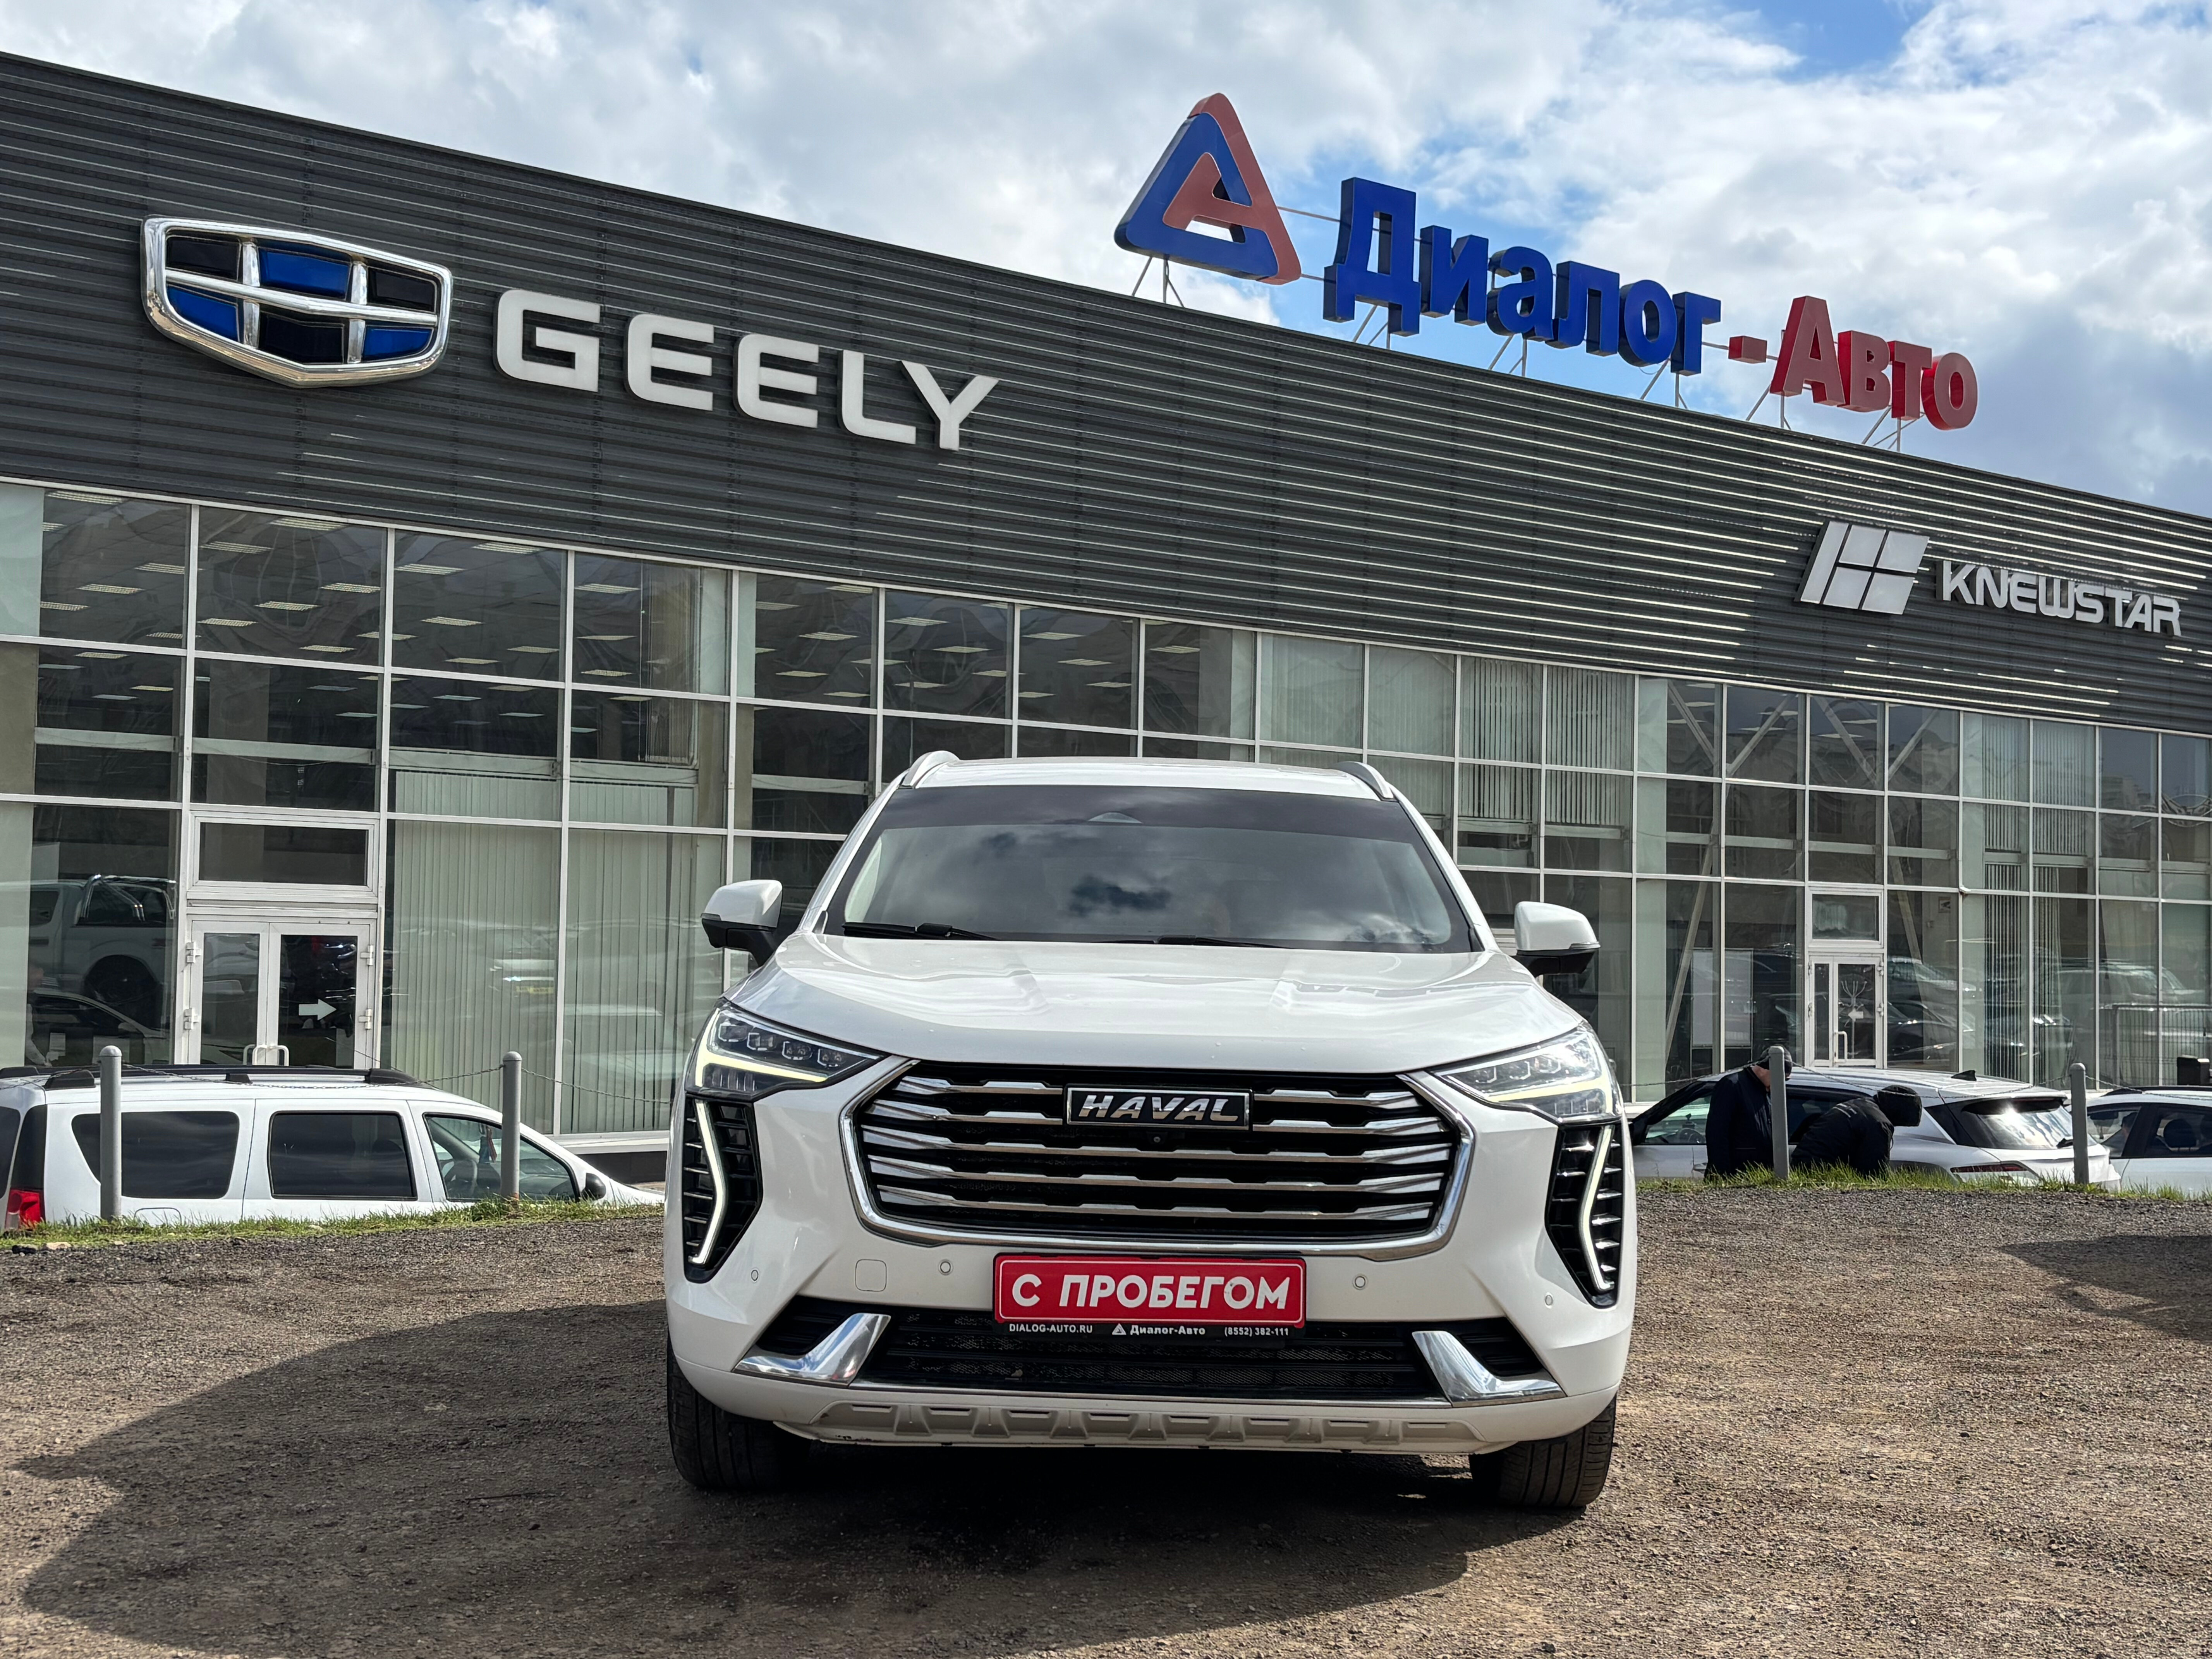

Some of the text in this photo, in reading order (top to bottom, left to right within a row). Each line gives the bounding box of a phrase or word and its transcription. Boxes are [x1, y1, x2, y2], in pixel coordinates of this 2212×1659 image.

[494, 289, 999, 451] GEELY
[1941, 560, 2181, 636] KNEWSTAR
[1079, 1094, 1239, 1122] HAVAL
[1012, 1273, 1290, 1309] С ПРОБЕГОМ
[1009, 1323, 1093, 1333] DIALOG-AUTO.RU
[1130, 1325, 1206, 1336] Диалог-Авто
[1224, 1326, 1288, 1337] (8552) 382-111
